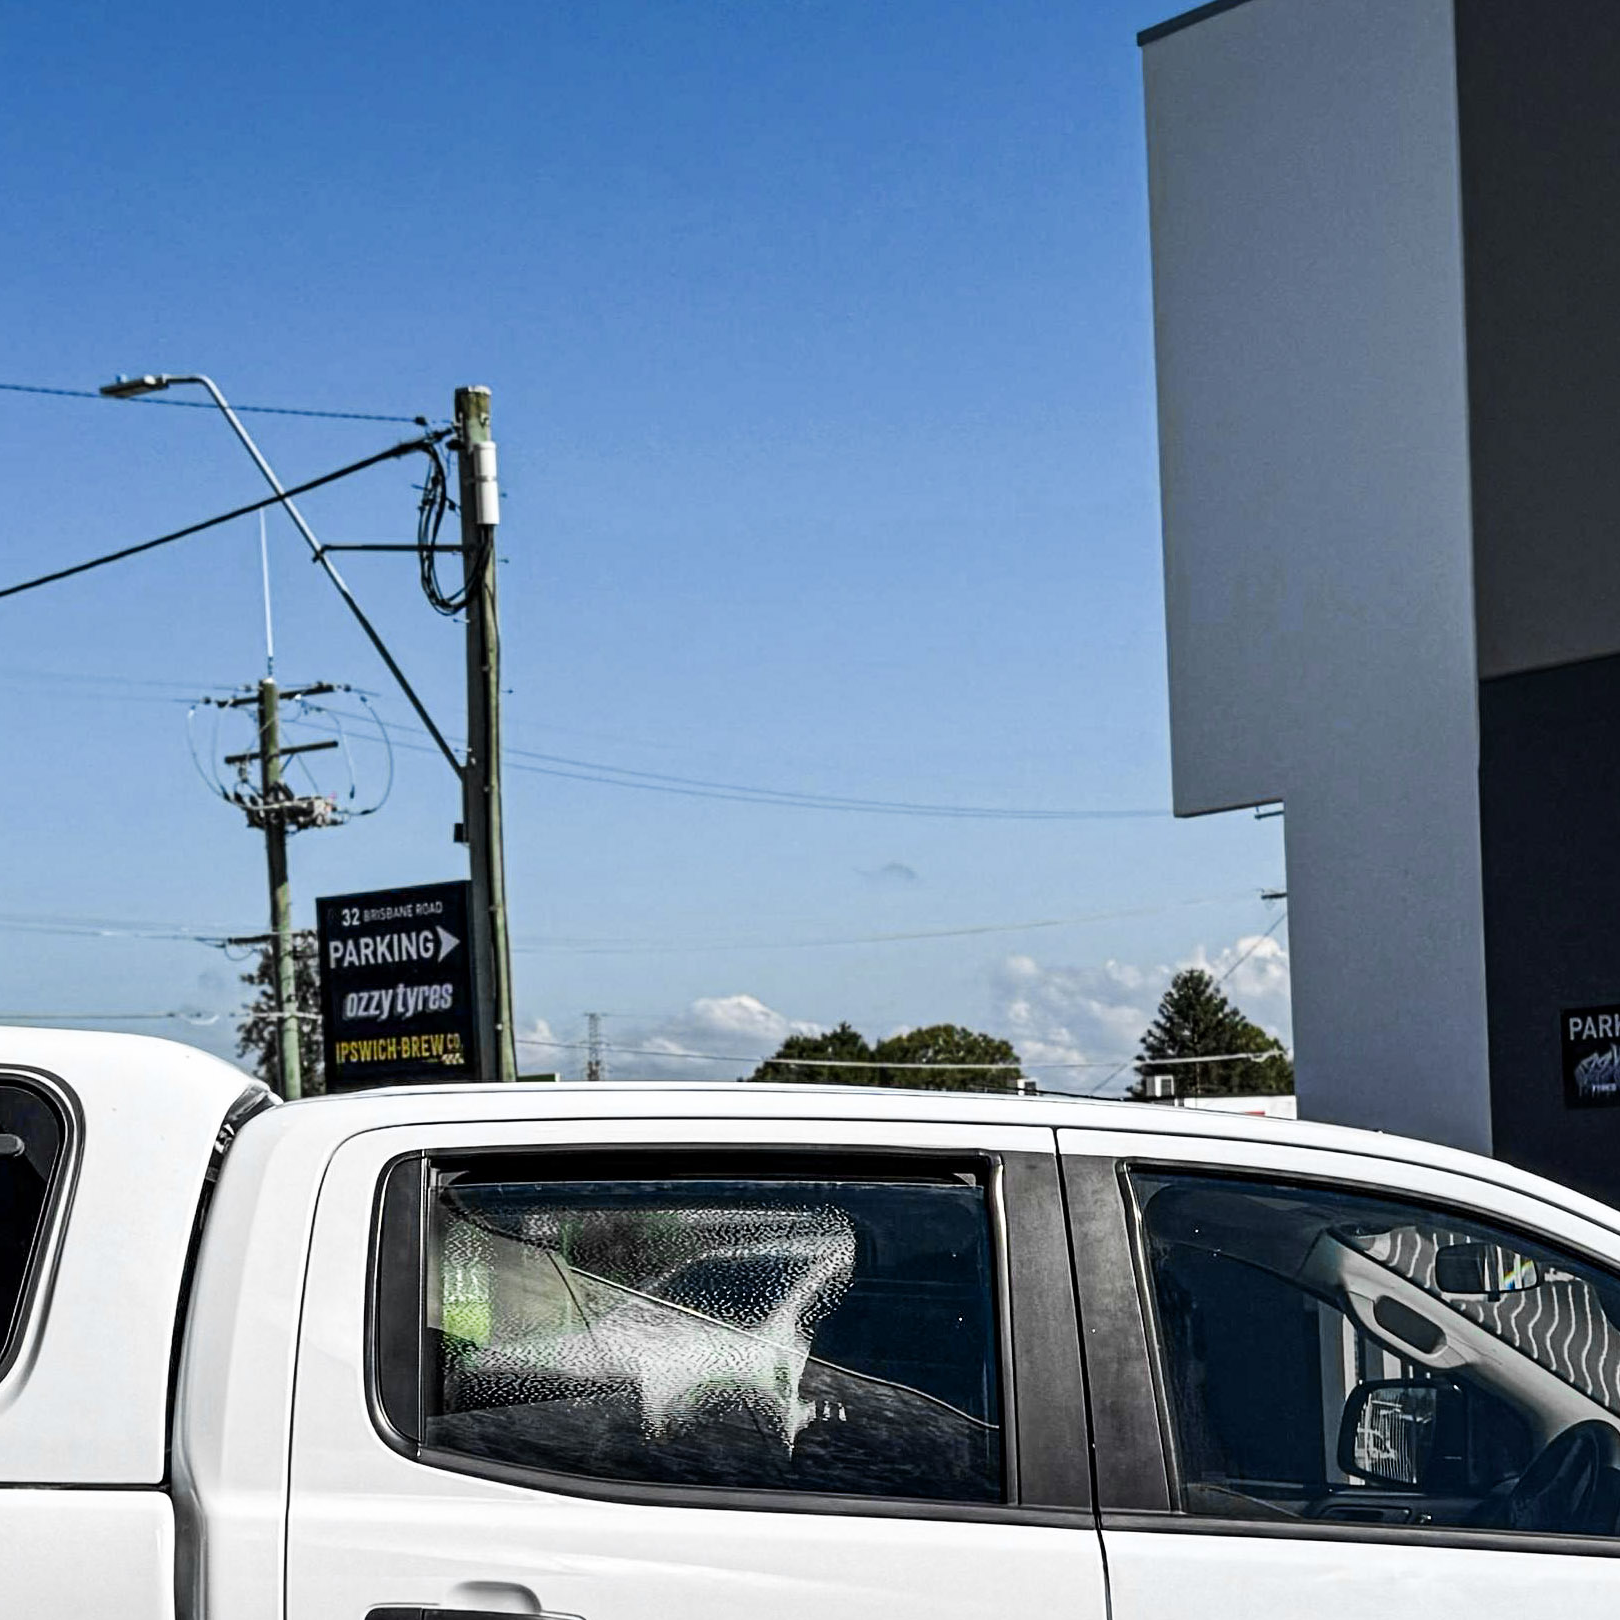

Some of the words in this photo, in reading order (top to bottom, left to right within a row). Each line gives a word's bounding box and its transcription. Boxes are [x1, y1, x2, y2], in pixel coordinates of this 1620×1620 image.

[341, 908, 360, 926] 32
[363, 904, 413, 922] BRISBANE
[415, 901, 443, 916] ROAD
[329, 930, 434, 969] PARKING
[394, 983, 454, 1021] tyres
[335, 1037, 397, 1064] IPSWICH
[401, 1034, 444, 1058] BREW
